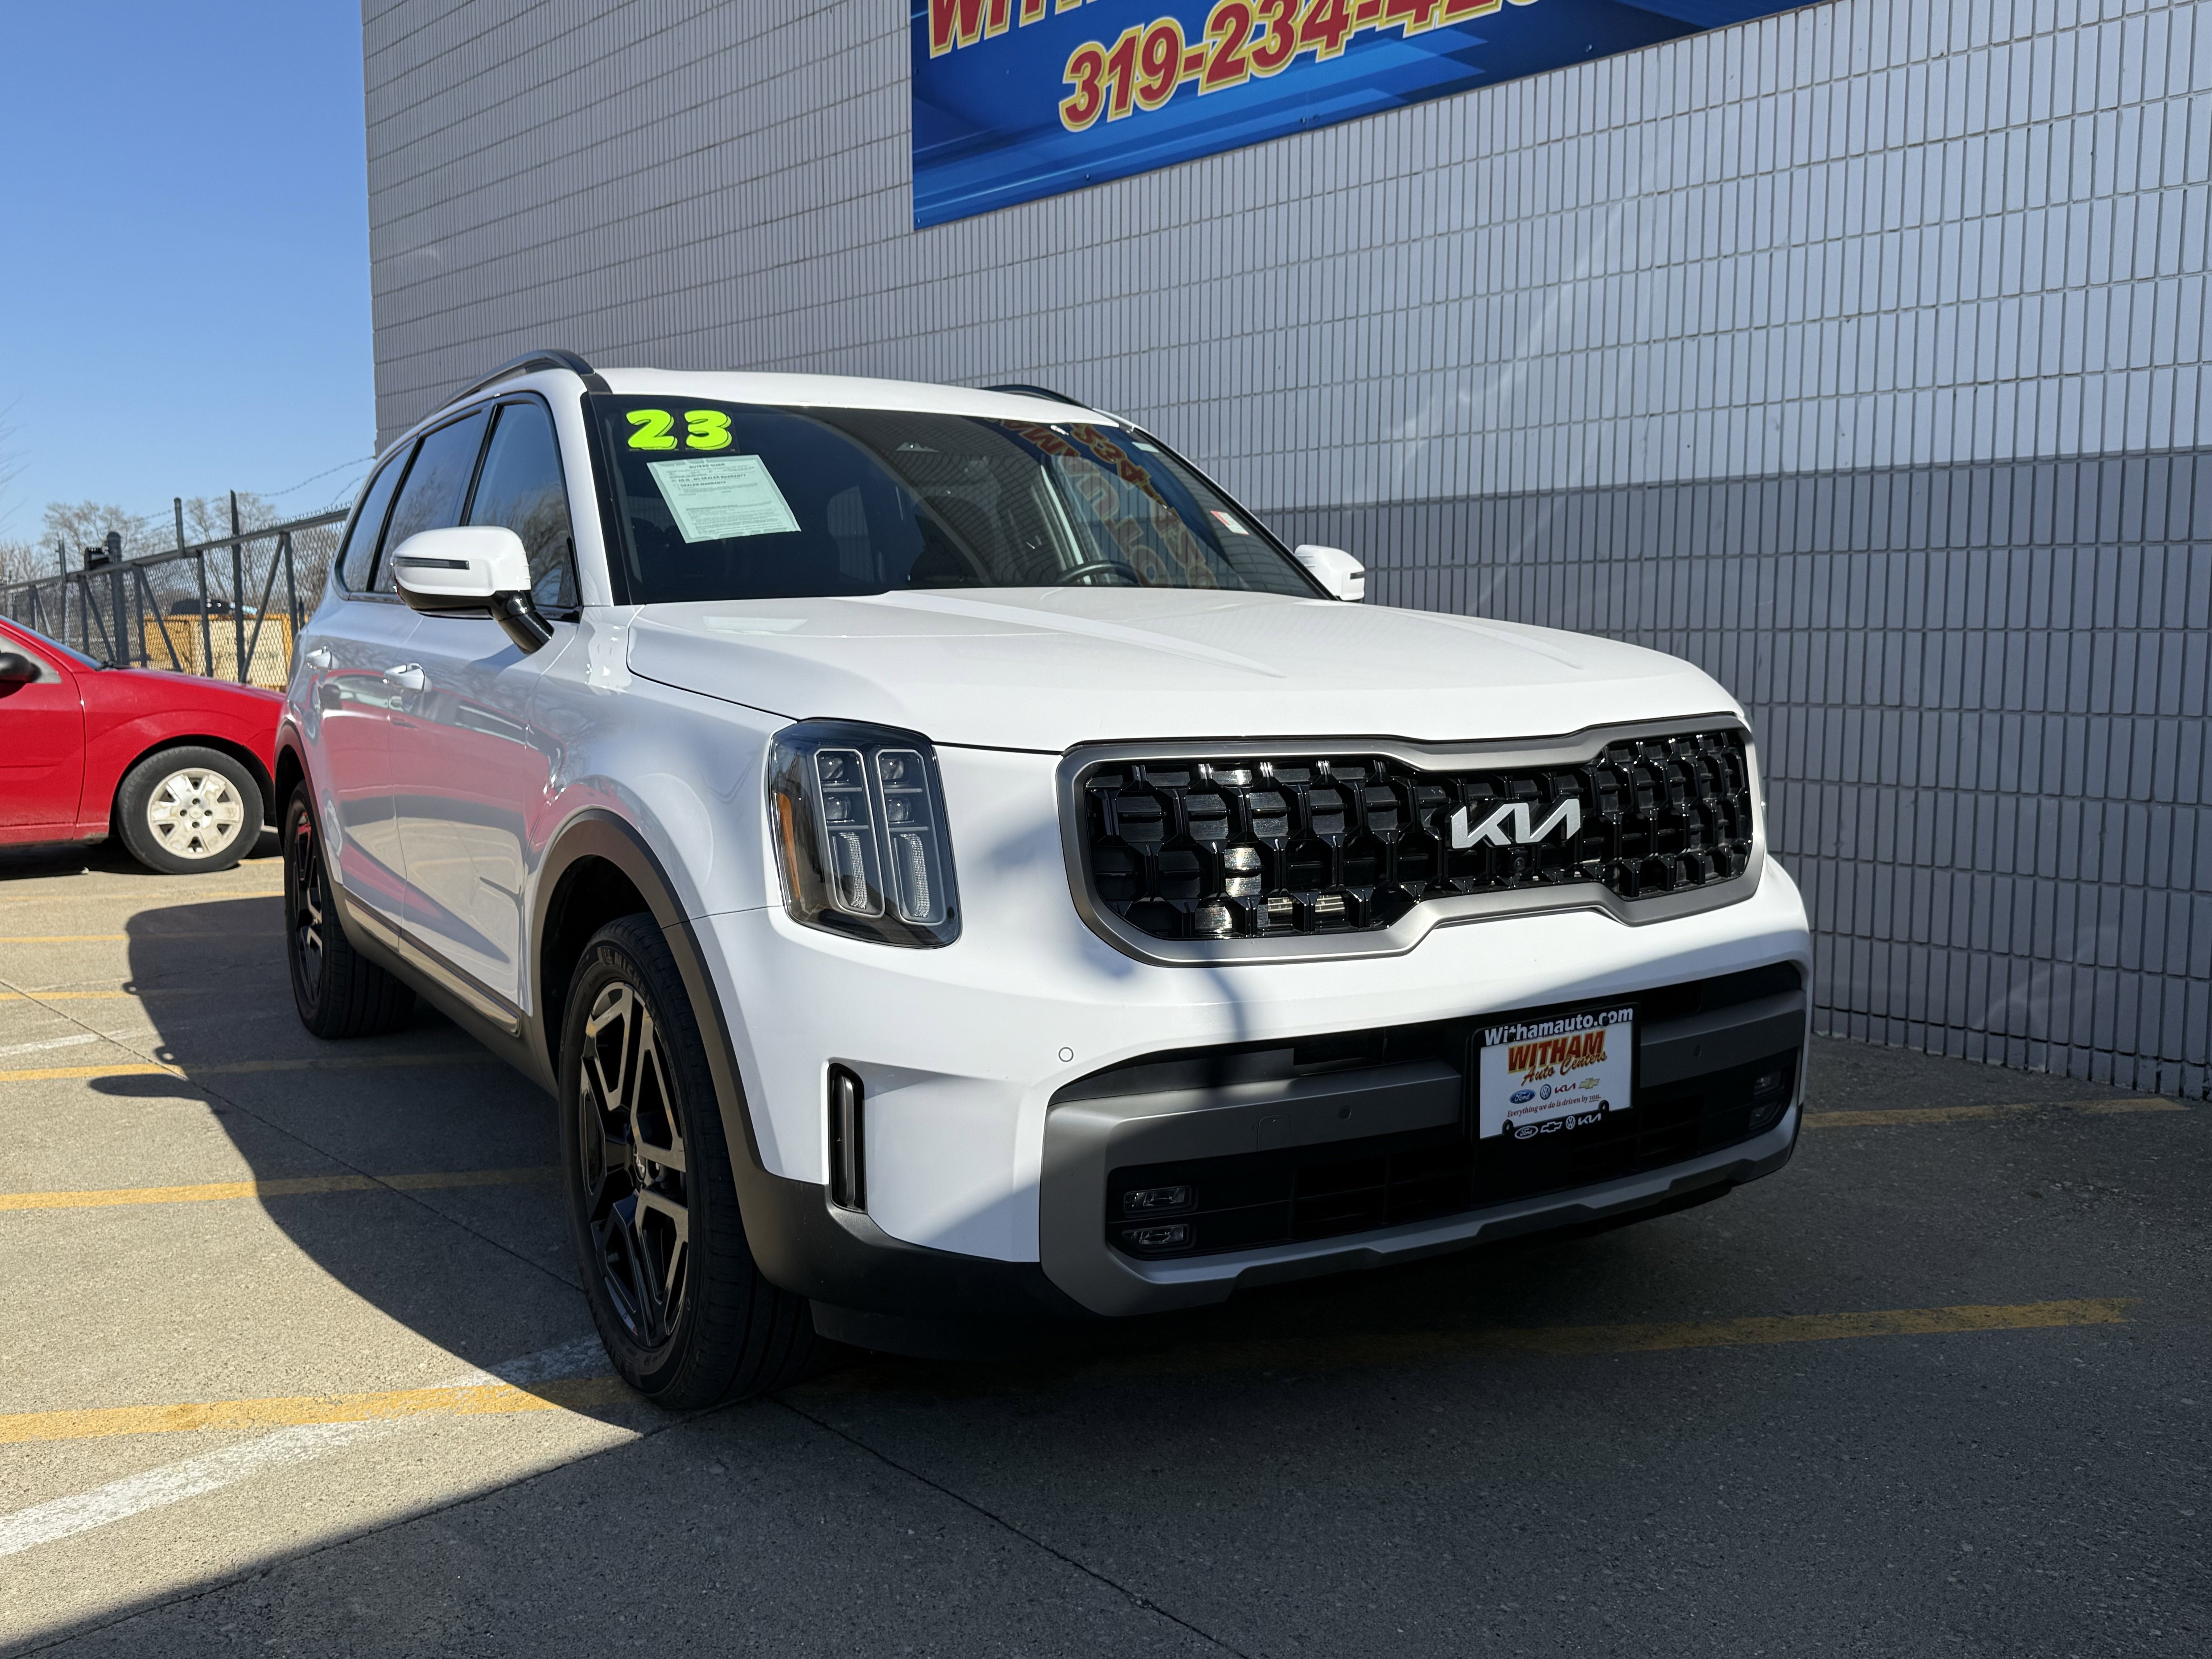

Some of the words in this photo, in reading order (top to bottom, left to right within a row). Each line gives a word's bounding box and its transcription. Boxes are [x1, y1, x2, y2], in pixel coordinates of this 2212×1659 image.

[1059, 0, 1542, 132] 319-234-
[626, 409, 732, 450] 23
[1452, 798, 1581, 849] KIA
[1507, 1028, 1606, 1074] WITHAM
[1521, 1065, 1555, 1087] Auto
[1559, 1051, 1607, 1076] Centers
[1507, 1106, 1538, 1117] Everything
[1562, 1097, 1580, 1106] driven
[1582, 1095, 1589, 1103] by
